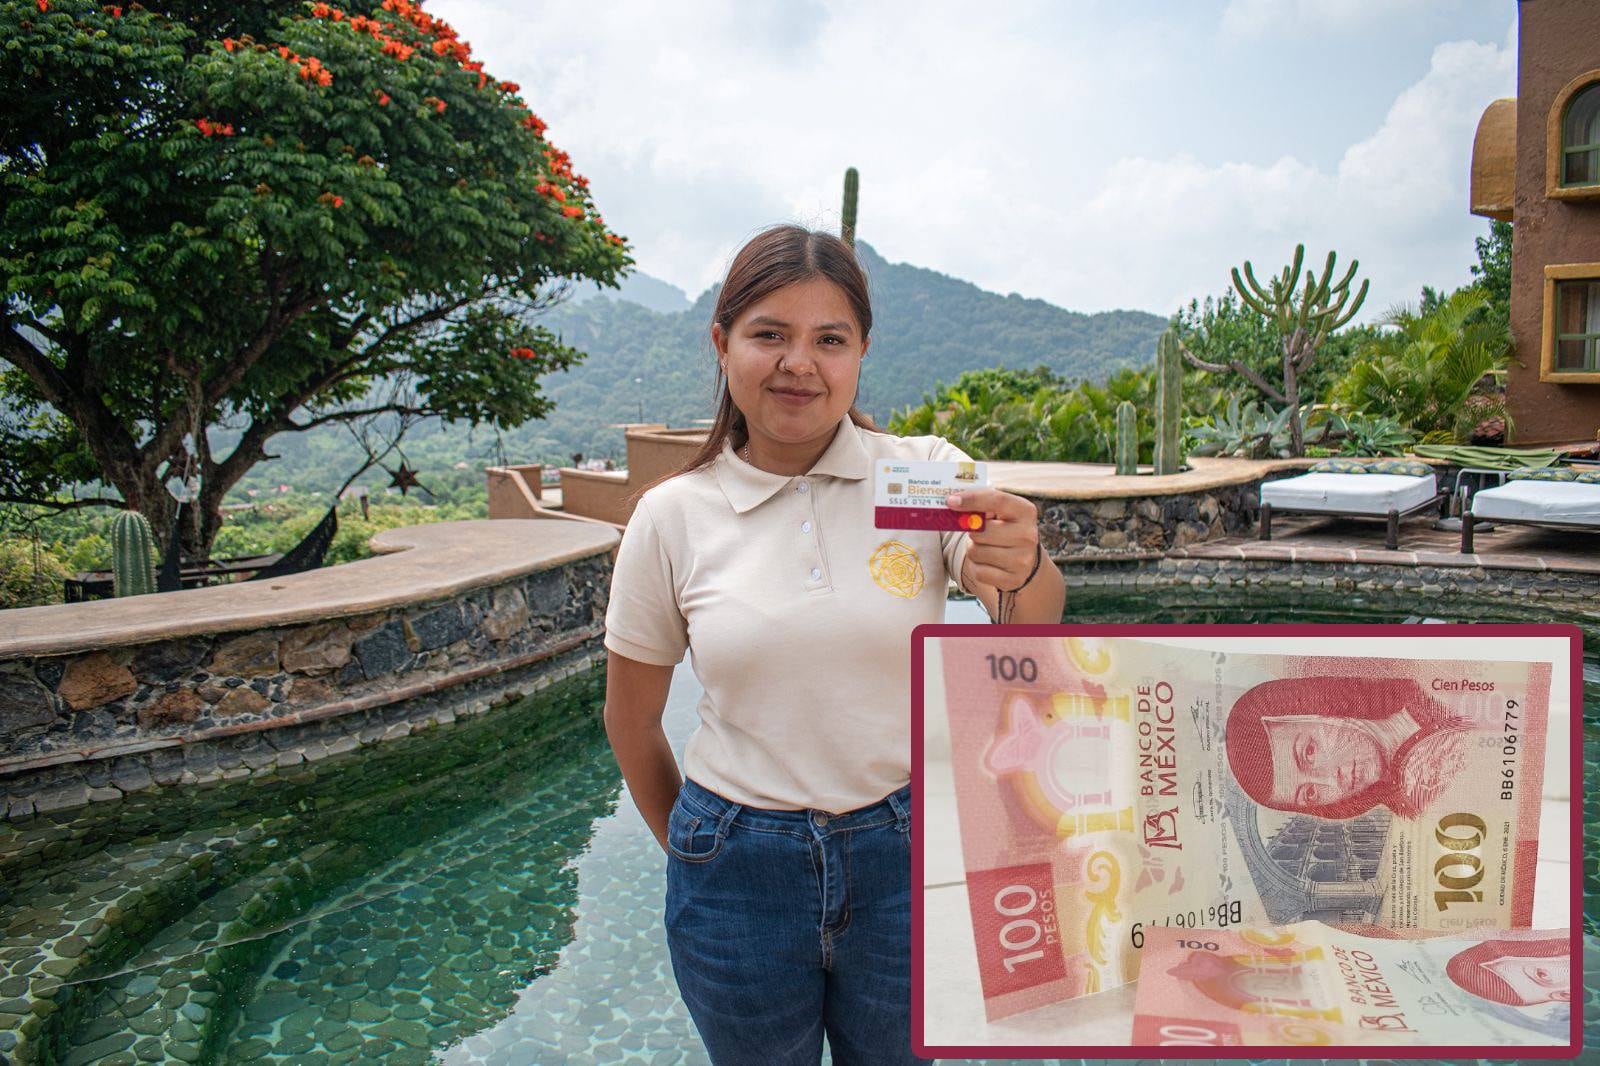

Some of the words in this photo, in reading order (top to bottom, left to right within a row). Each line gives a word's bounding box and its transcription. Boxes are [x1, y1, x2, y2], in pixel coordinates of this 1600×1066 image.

[889, 497, 908, 505] 5515
[907, 485, 965, 496] Bienesta
[985, 654, 1038, 683] 100
[1431, 679, 1458, 692] Cien
[1461, 679, 1495, 692] Pesos
[1137, 685, 1151, 712] DE
[1138, 721, 1154, 796] BANCO
[1154, 681, 1178, 796] MÉXICO
[1501, 699, 1520, 801] BB6106779
[1434, 812, 1487, 912] 100
[994, 884, 1045, 974] 100
[1039, 889, 1059, 945] PESOS
[1176, 940, 1220, 952] 100
[1338, 961, 1367, 1005] BANCO
[1351, 950, 1401, 1008] MÉXICO
